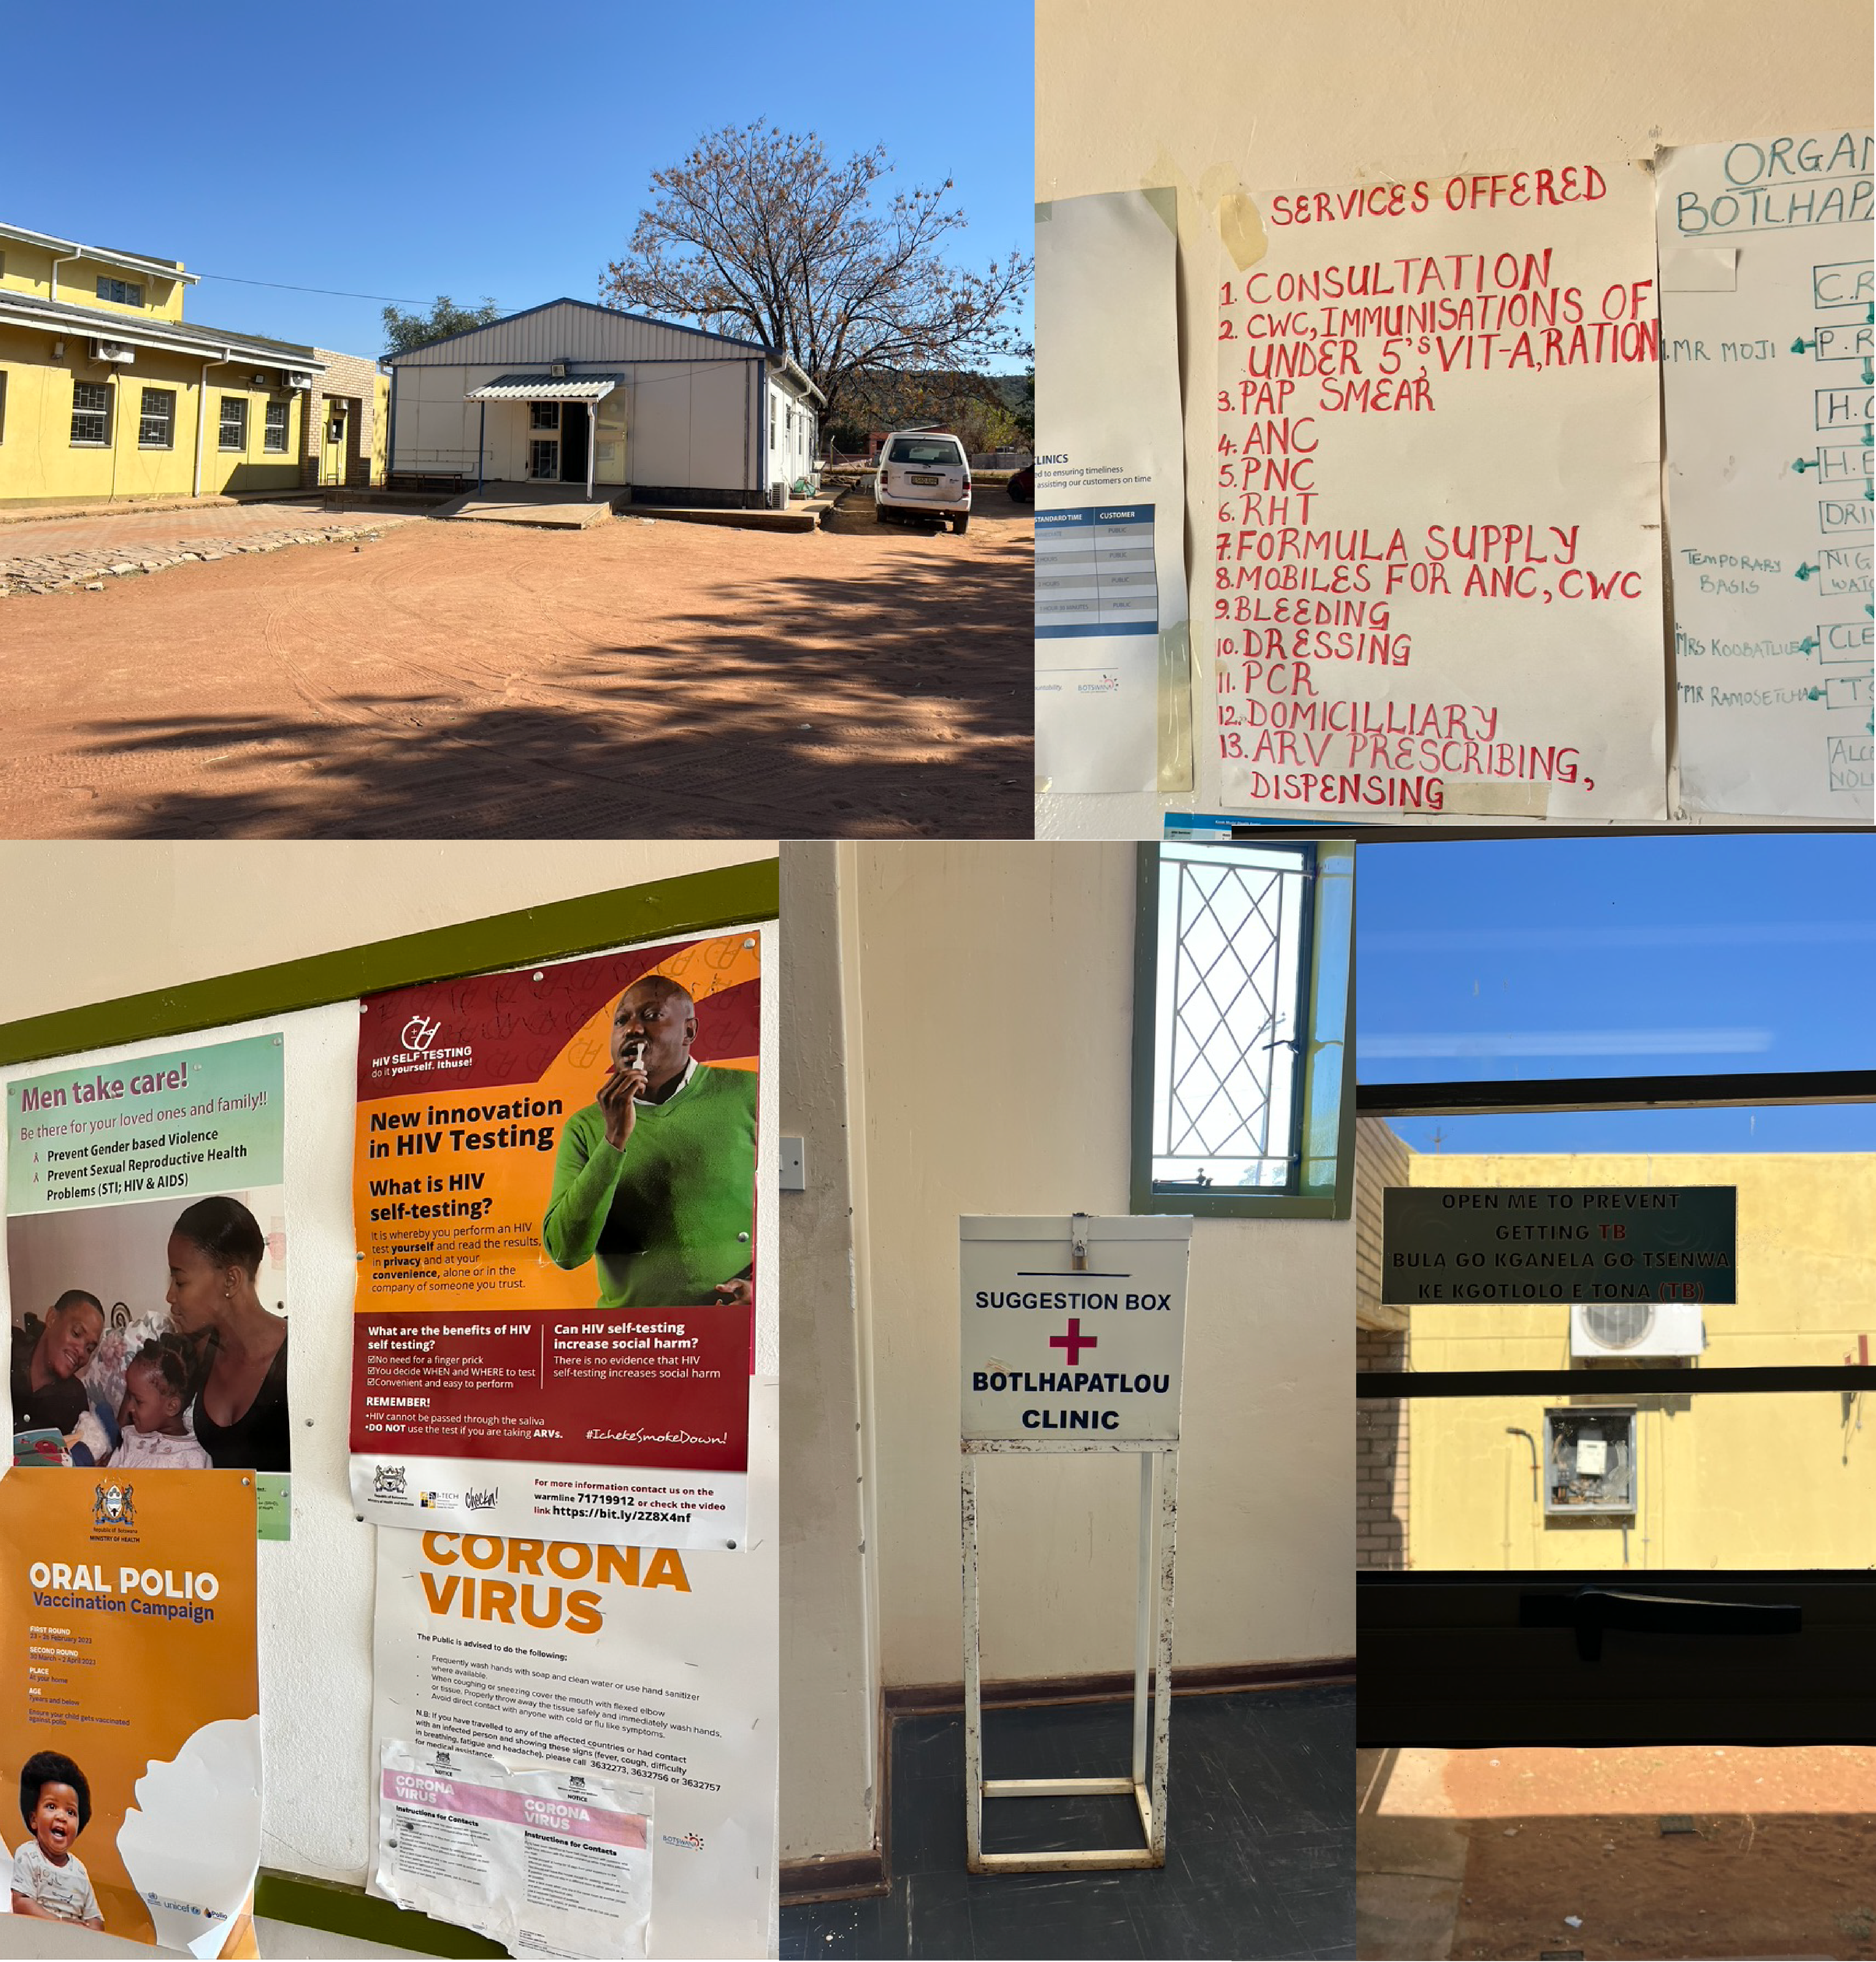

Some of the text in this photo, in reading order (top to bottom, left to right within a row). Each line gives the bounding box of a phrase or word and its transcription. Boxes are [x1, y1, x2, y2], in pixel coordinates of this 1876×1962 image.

[1271, 165, 1606, 225] SERVICES OFFERED
[1222, 247, 1553, 308] 1. CONSULTATION
[1218, 320, 1237, 340] 2.
[1602, 279, 1652, 320] OF
[1249, 339, 1363, 379] UNDER
[1721, 340, 1775, 362] MOJI
[1218, 374, 1435, 414] 3. PAP SMEAR
[1218, 418, 1319, 456] 4. ANC
[1037, 480, 1066, 489] assisting
[1053, 468, 1084, 477] ensuring
[1218, 457, 1314, 491] 5. PNC
[1218, 492, 1319, 526] 6. RHT
[1425, 524, 1579, 564] SUPPLY
[1681, 549, 1780, 572] TEMPORARY
[1386, 562, 1451, 595] FOR
[1700, 575, 1760, 595] BASIS
[1217, 628, 1411, 668] 10. DRESSING
[1219, 661, 1319, 696] 11. PCR
[1219, 699, 1497, 745] 12. DOMICILLIARY
[1219, 733, 1248, 758] 13.
[1252, 729, 1333, 767] ARV
[1251, 771, 1443, 810] DISPENSING
[372, 1046, 472, 1067] HIV SELF TESTING
[392, 1062, 435, 1076] yourself.
[22, 1062, 189, 1113] Men take care!
[21, 1091, 266, 1140] Be there for your loved ones and family!!
[371, 1098, 562, 1132] New innovation
[49, 1130, 218, 1161] Prevent Gender based Violence
[370, 1124, 554, 1158] in HIV Testing
[48, 1145, 246, 1181] Prevent Sexual Reproductive Health
[48, 1185, 95, 1200] Problems
[125, 1179, 144, 1192] HIV
[147, 1178, 155, 1189] &
[158, 1173, 187, 1187] AIDS)
[370, 1173, 485, 1196] What is HIV
[371, 1198, 493, 1221] self-testing?
[1441, 1194, 1680, 1210] OPEN ME TO PREVENT
[1495, 1224, 1626, 1241] GETTING TB
[1392, 1251, 1730, 1268] BULA GO KGANELA GO TSENWA
[976, 1291, 1171, 1310] SUGGESTION BOX
[1420, 1285, 1442, 1298] KE
[1574, 1285, 1583, 1299] E
[1590, 1283, 1652, 1299] TONA
[1659, 1283, 1705, 1302] (TB)
[555, 1322, 685, 1335] Can HIV self-testing
[555, 1338, 698, 1348] increase social harm?
[974, 1372, 1169, 1393] BOTLHAPATLOU
[367, 1397, 429, 1406] REMEMBER!
[1023, 1410, 1119, 1429] CLINIC
[534, 1493, 574, 1503] warmline
[578, 1493, 634, 1506] 71719912
[422, 1530, 691, 1592] CORONA
[30, 1563, 218, 1601] ORAL POLIO
[33, 1592, 214, 1623] Vaccination Campaign
[420, 1571, 603, 1634] VIRUS
[433, 1636, 453, 1644] Public
